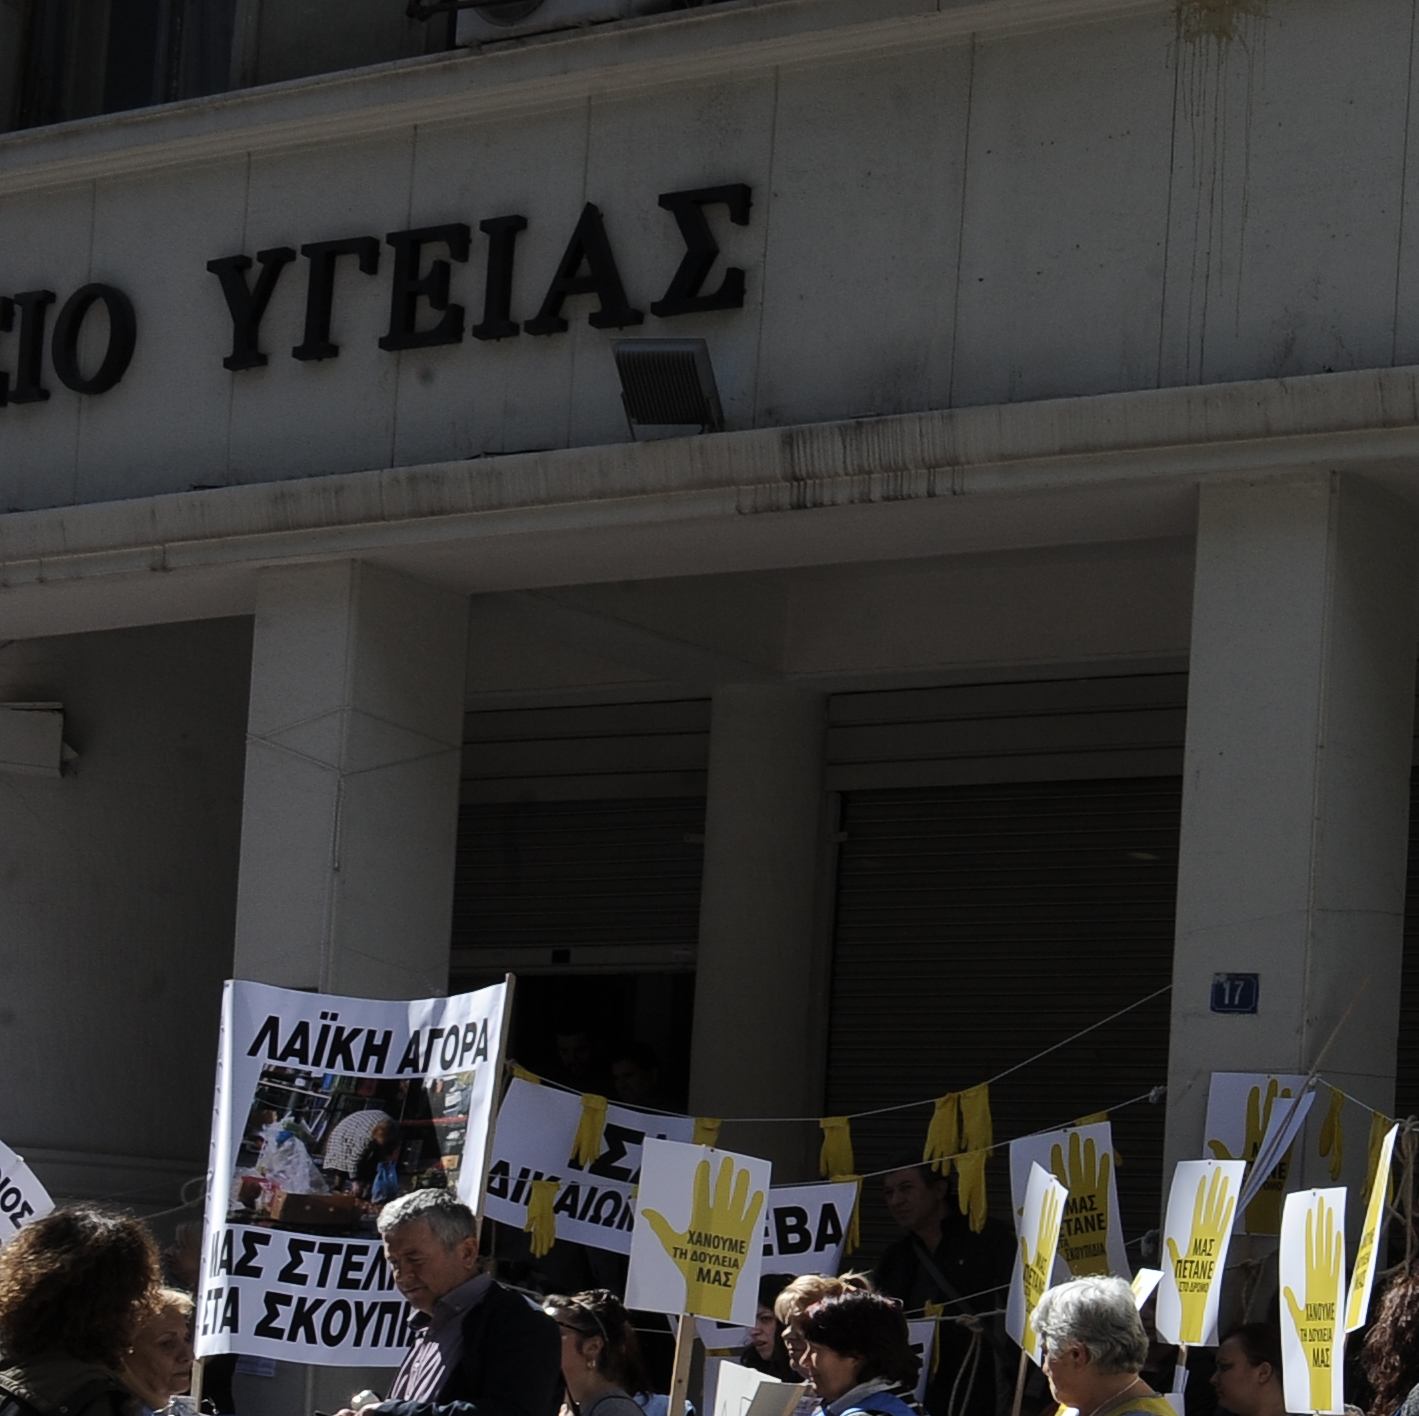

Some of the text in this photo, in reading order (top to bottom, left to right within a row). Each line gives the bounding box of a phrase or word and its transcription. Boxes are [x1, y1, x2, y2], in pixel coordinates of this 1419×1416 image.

[207, 183, 752, 371] ΥΓΕΙΑΣ
[1221, 980, 1245, 1005] 17
[247, 1010, 489, 1075] ΛΑΪΚΗ ΑΓΟΡΑ
[0, 1168, 35, 1230] ΙΟΣ
[1065, 1194, 1098, 1216] ΜΑΣ
[1060, 1213, 1106, 1238] ΤΑΝΕ
[687, 1229, 746, 1255] ΧΑΝΟΥΜΕ
[1192, 1237, 1216, 1257] ΜΑΣ
[278, 1237, 395, 1291] ΣΤΕΛ
[672, 1246, 740, 1270] ΤΗ ΔΟΥΛΕΙΑ
[1174, 1259, 1215, 1280] ΠΕΤΑΝΕ
[696, 1266, 733, 1288] ΜΑΣ
[1305, 1302, 1335, 1321] ΧΑΝΟΥΜΕ
[1312, 1347, 1330, 1367] ΜΑΣ
